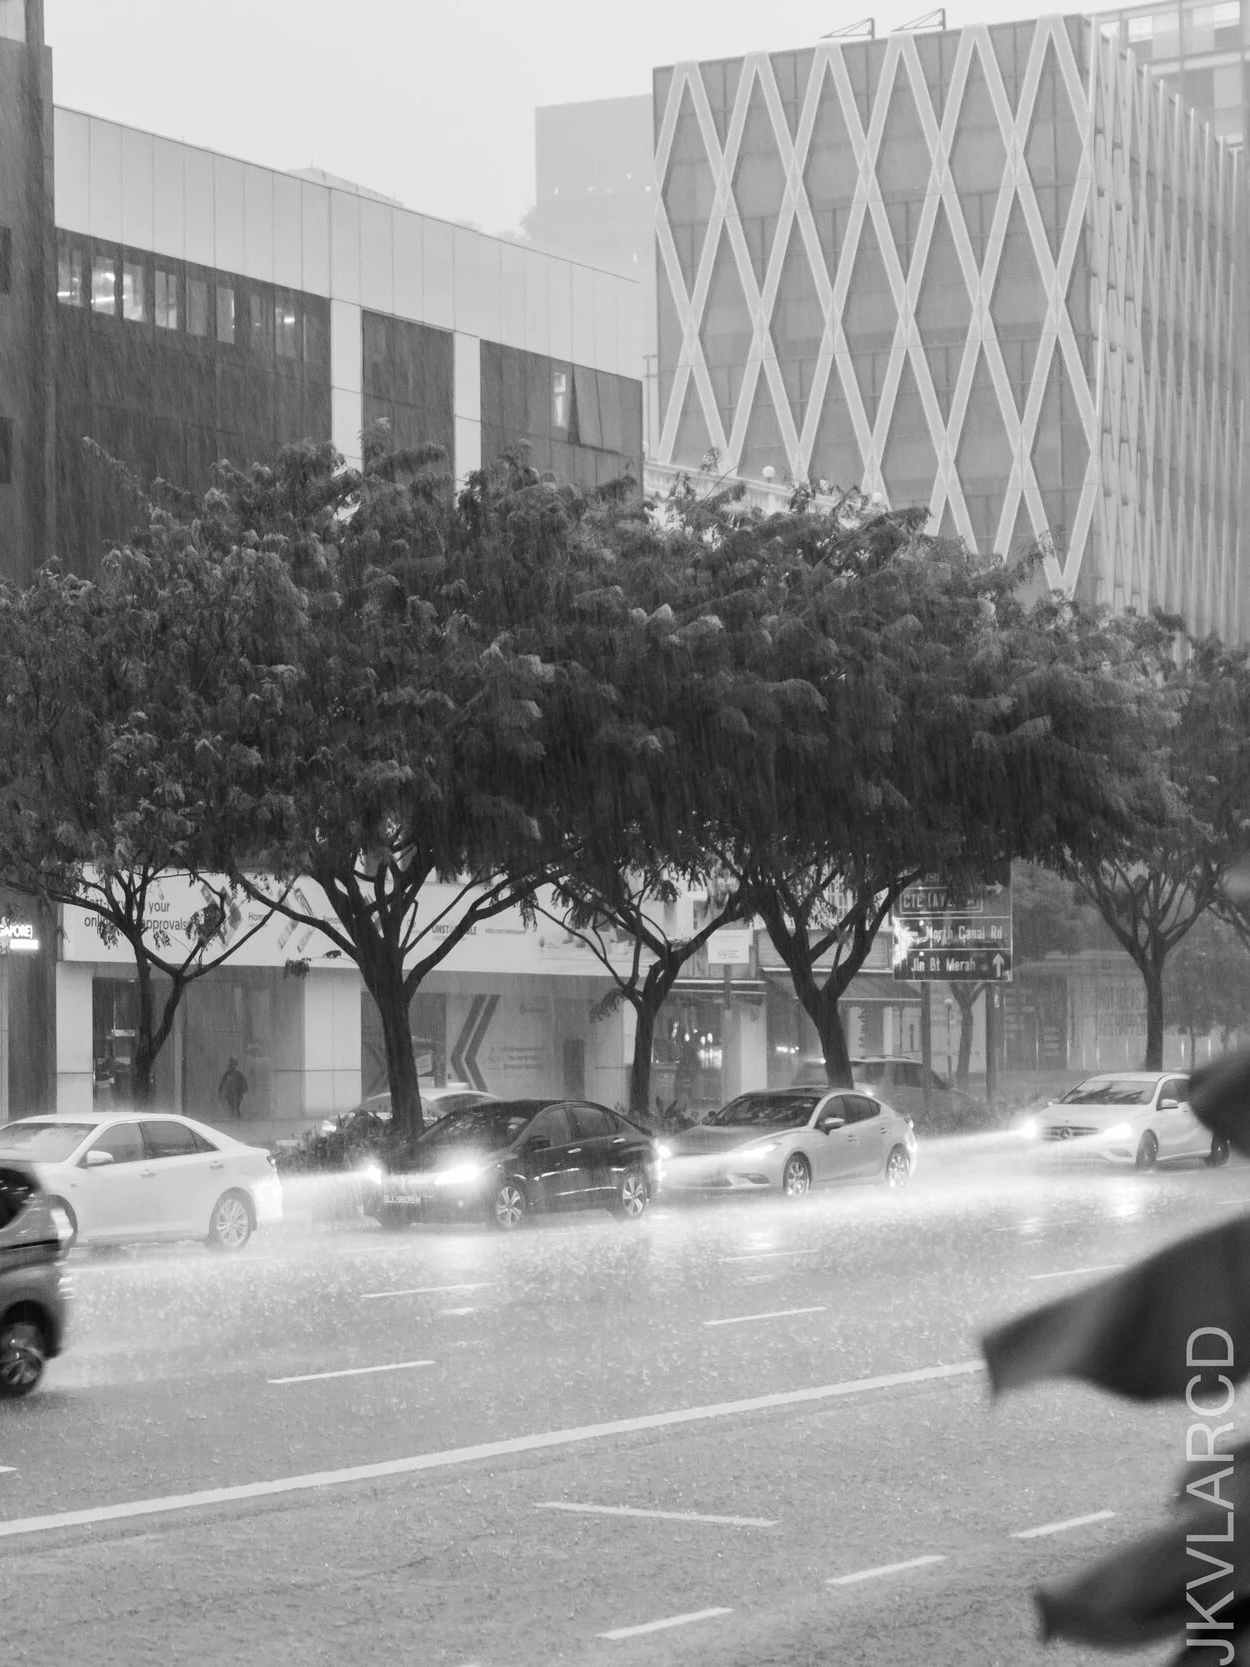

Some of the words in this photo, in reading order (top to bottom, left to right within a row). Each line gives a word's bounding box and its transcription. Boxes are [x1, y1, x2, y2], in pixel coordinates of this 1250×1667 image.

[148, 902, 170, 914] your
[903, 893, 922, 908] CTE
[928, 893, 954, 908] (AY
[248, 912, 265, 921] Hom
[925, 925, 954, 940] North
[958, 925, 985, 939] Canal
[990, 925, 1003, 939] Rd
[911, 958, 925, 972] Jln
[930, 957, 940, 971] Bt
[946, 957, 976, 972] Merah
